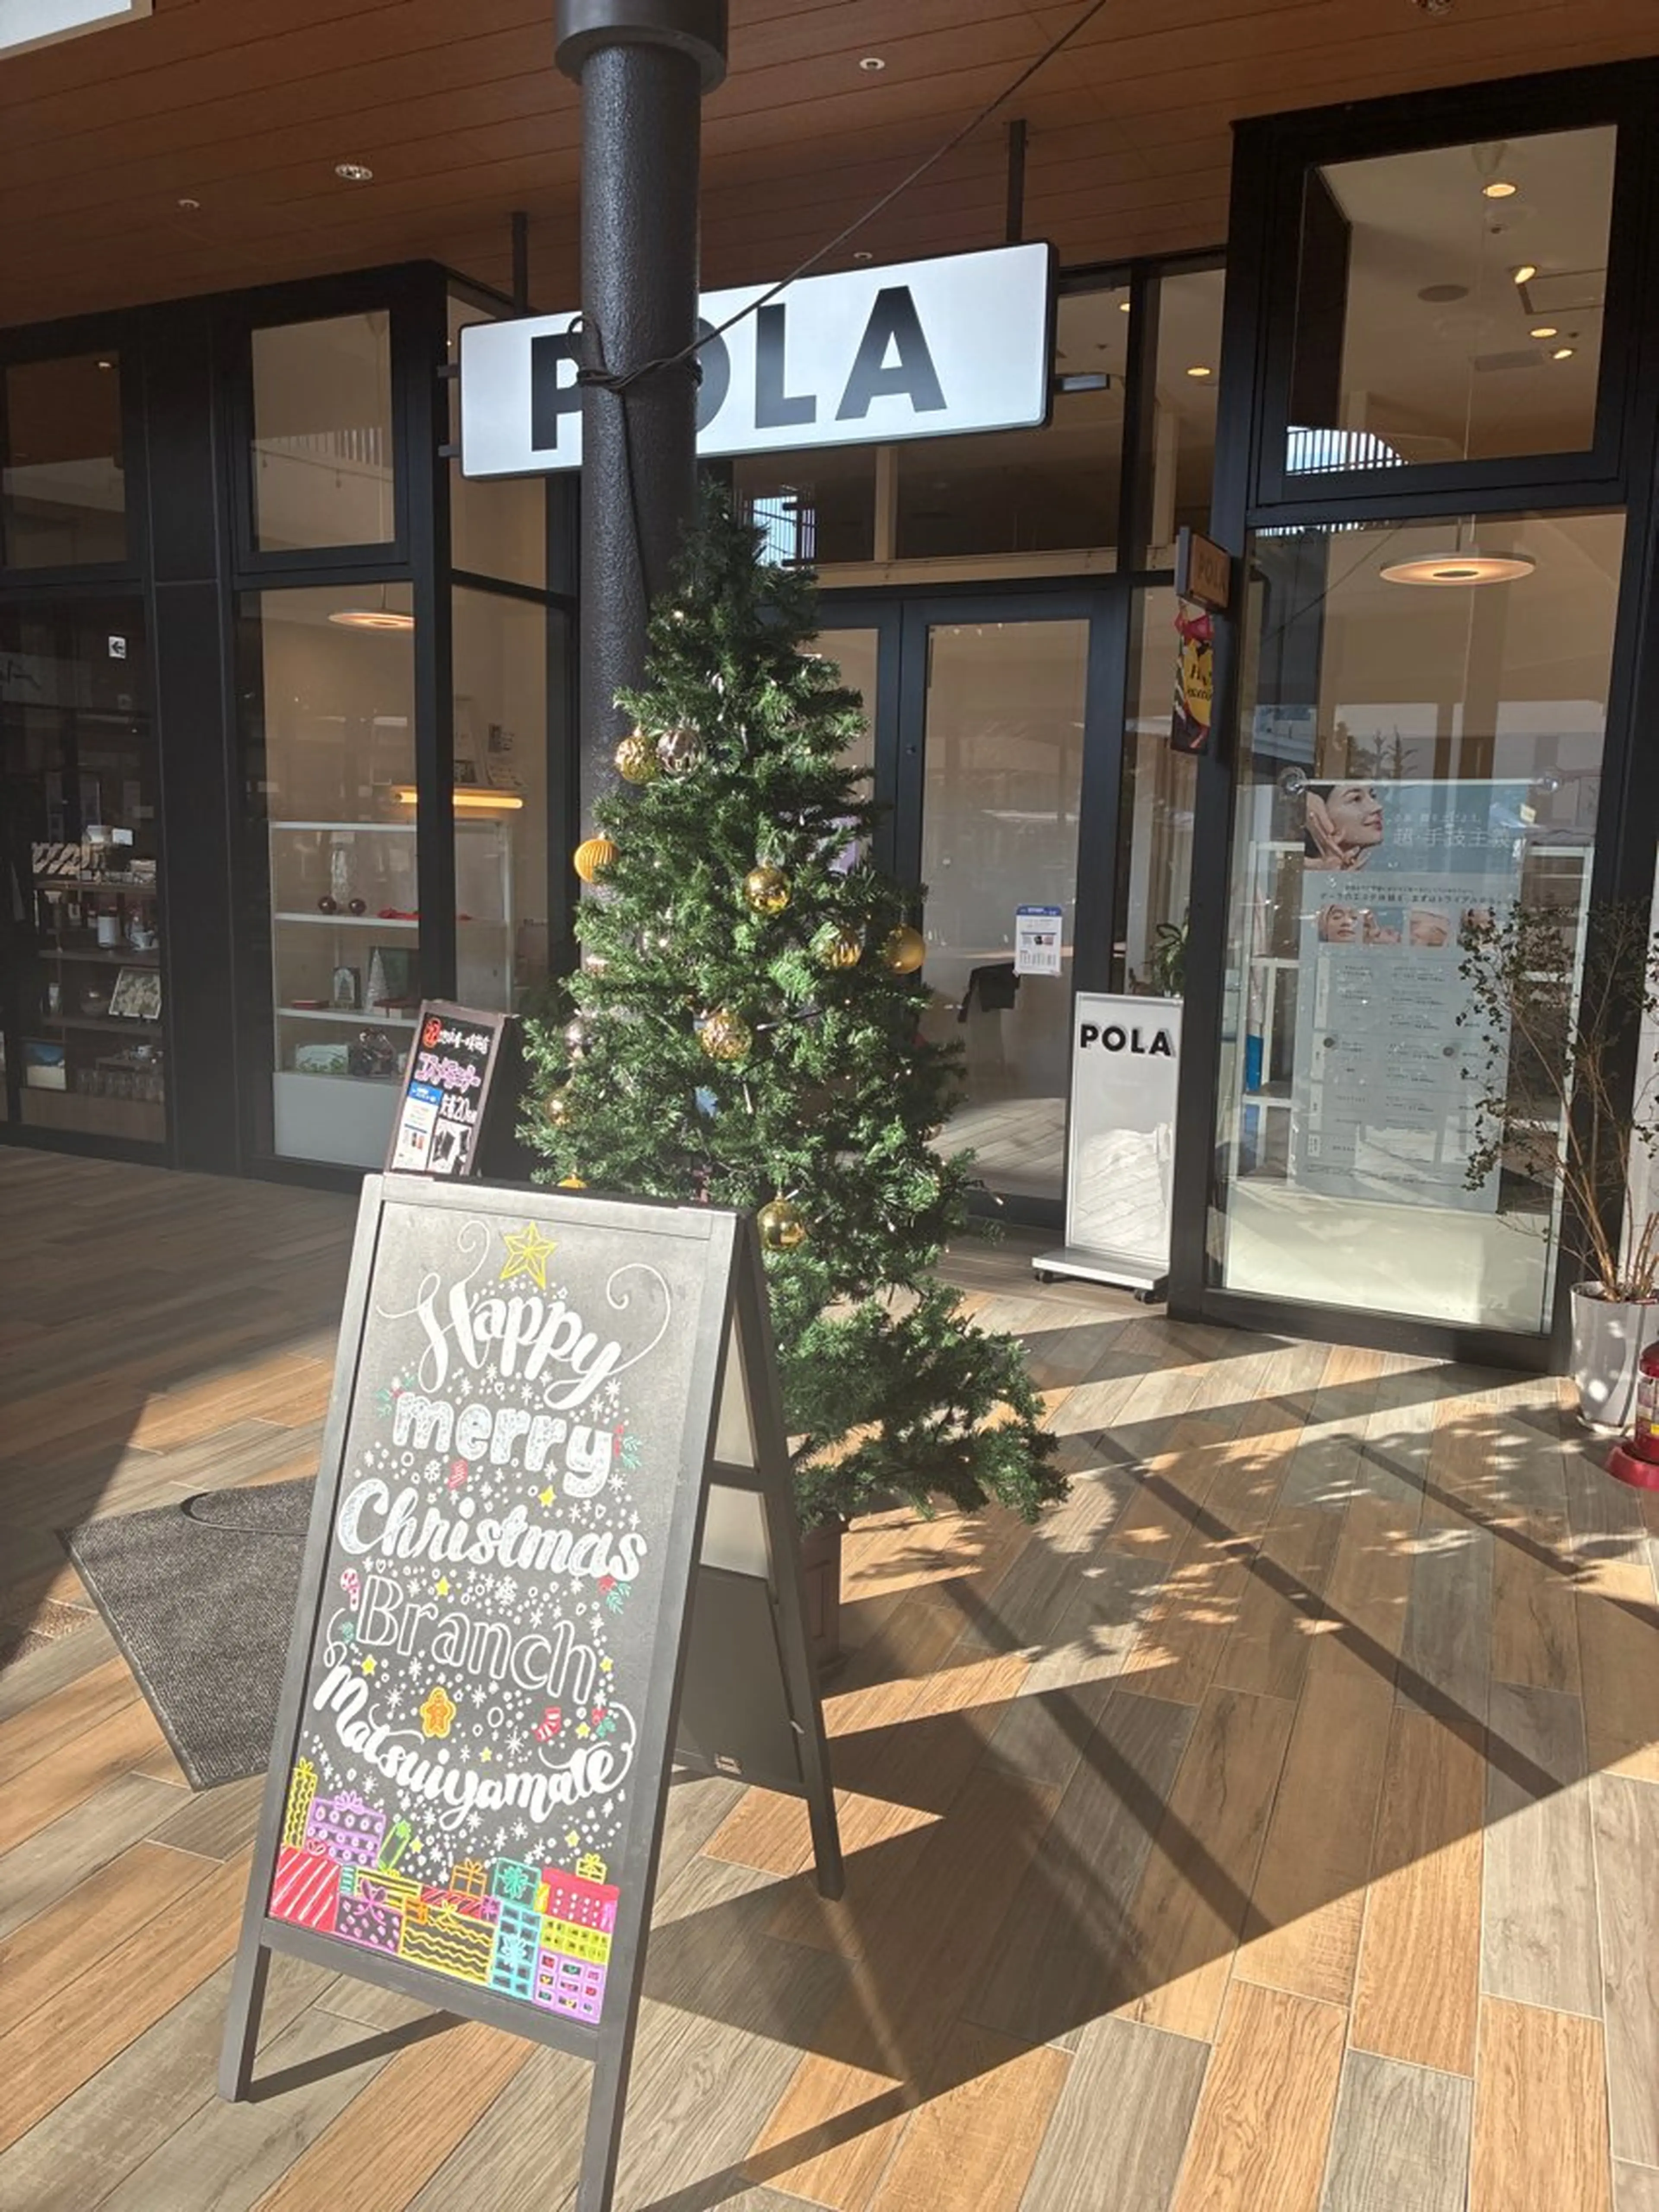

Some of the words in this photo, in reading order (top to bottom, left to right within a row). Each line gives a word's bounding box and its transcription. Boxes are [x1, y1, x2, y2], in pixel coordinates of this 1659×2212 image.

[531, 285, 947, 451] PLA
[1080, 1023, 1172, 1056] POLA
[376, 1249, 652, 1409] Happy
[392, 1392, 613, 1498] merry
[337, 1478, 648, 1582] Christmas
[356, 1574, 597, 1705] Branch
[313, 1618, 636, 1831] Matsuiyamate
